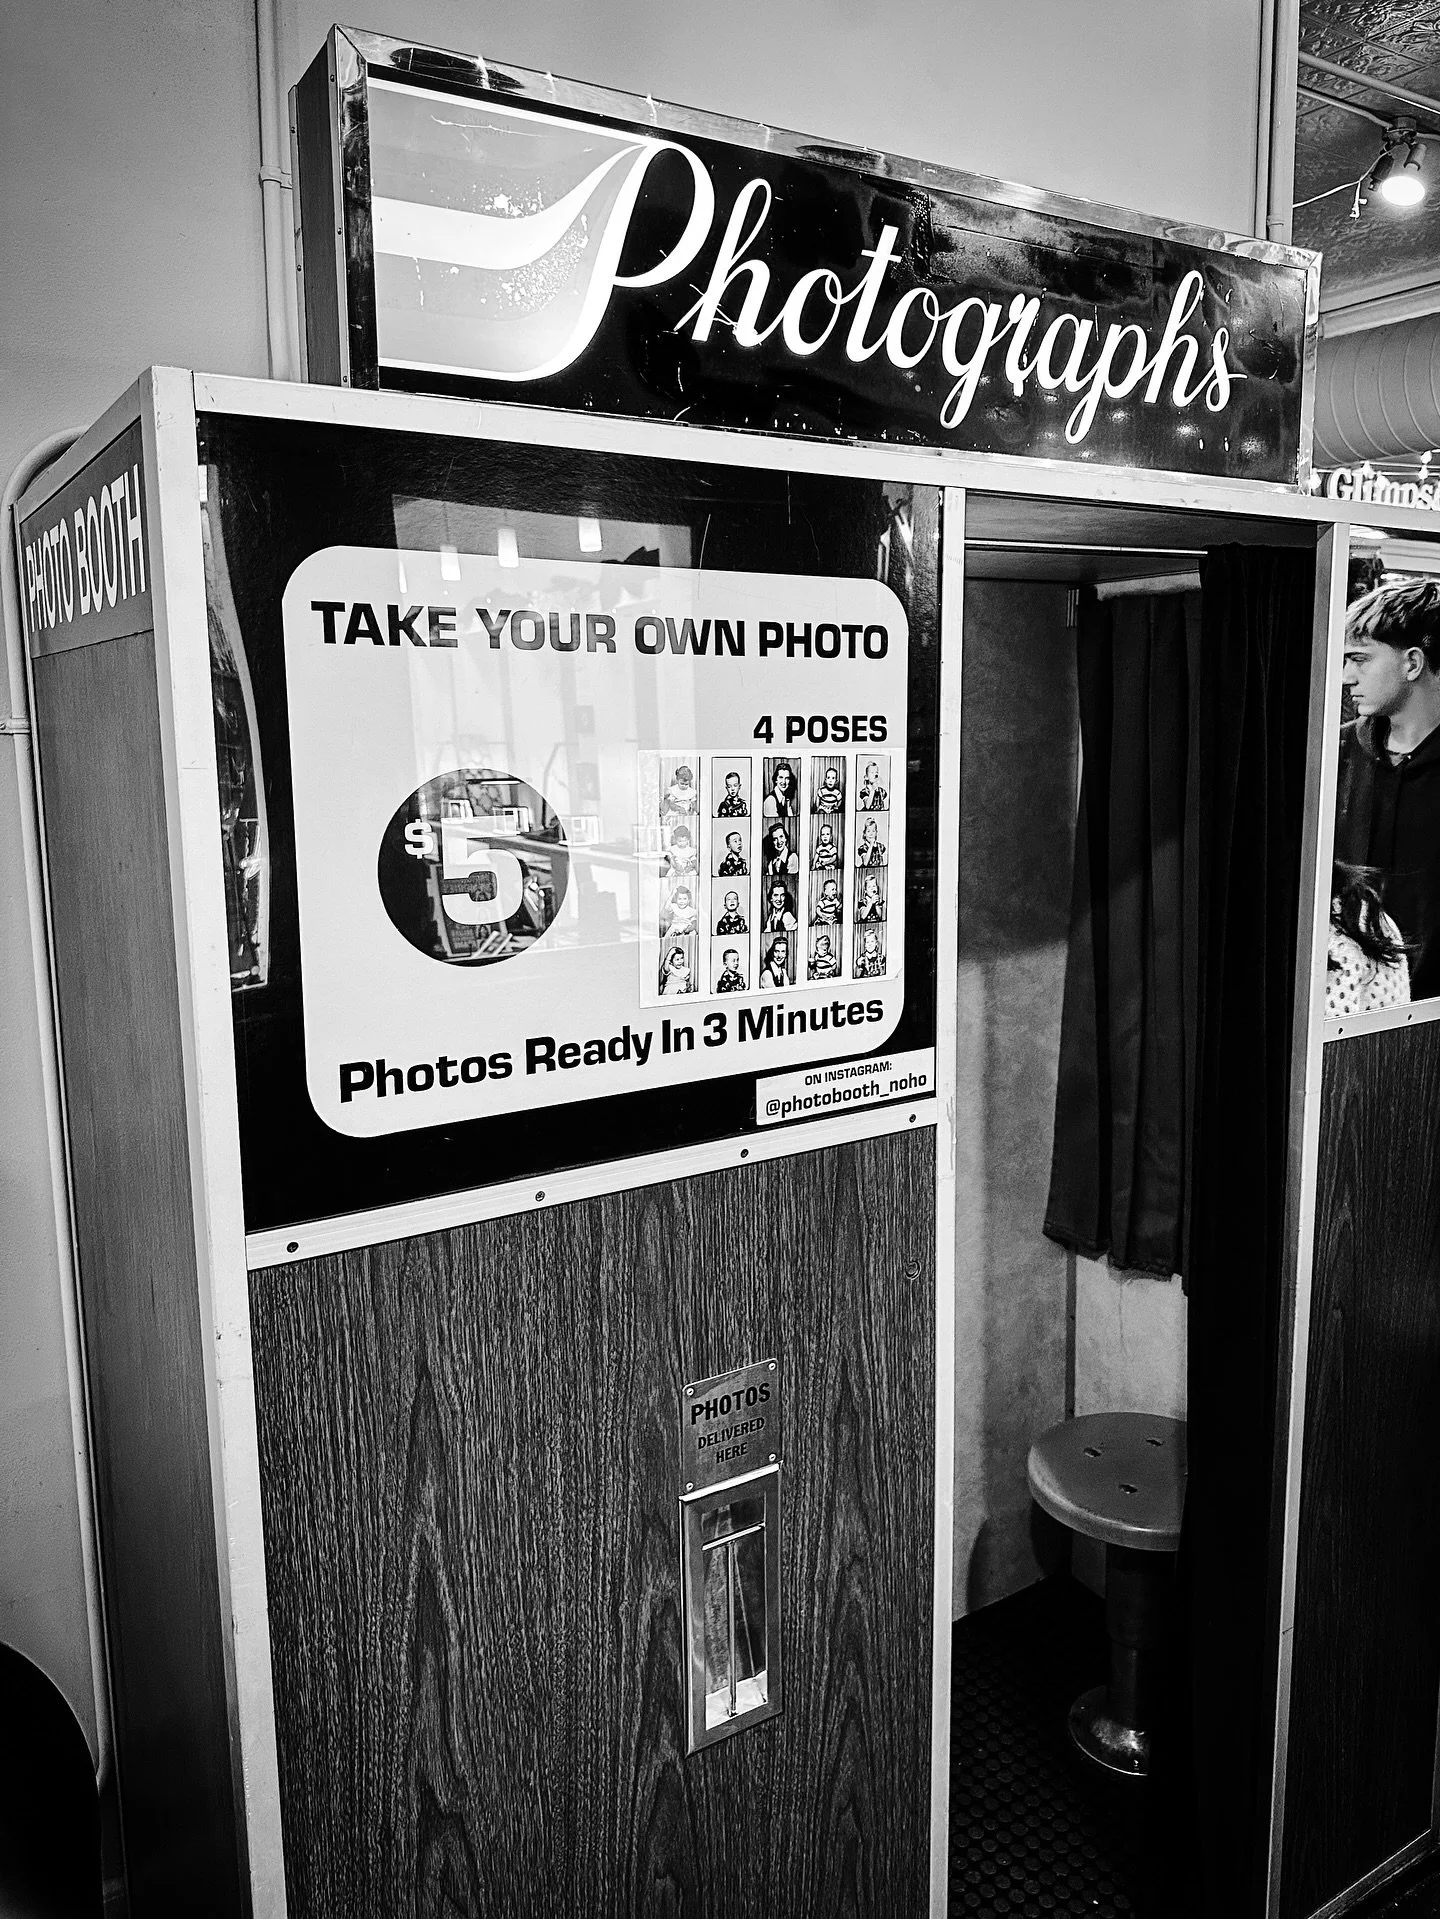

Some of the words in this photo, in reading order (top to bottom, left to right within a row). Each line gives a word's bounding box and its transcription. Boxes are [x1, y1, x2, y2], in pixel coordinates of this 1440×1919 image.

[520, 138, 1247, 444] Photographs
[25, 517, 74, 633] PHOTO
[74, 463, 146, 616] BOOTH
[311, 601, 459, 649] TAKE
[474, 608, 617, 654] YOUR
[633, 616, 746, 657] OWN
[758, 621, 889, 660] PHOTO
[752, 717, 774, 744] 4
[785, 715, 888, 744] POSES
[338, 1050, 513, 1104] Photos
[524, 1026, 654, 1076] Ready
[661, 1019, 696, 1053] In
[702, 1012, 729, 1048] 3
[737, 999, 885, 1042] Minutes
[804, 1073, 822, 1086] ON
[824, 1060, 893, 1083] INSTAGRAM:
[765, 1072, 928, 1119] @photobooth_noho
[691, 1382, 771, 1426] PHOTOS
[698, 1417, 765, 1450] DELIVERED
[716, 1442, 748, 1464] HERE
